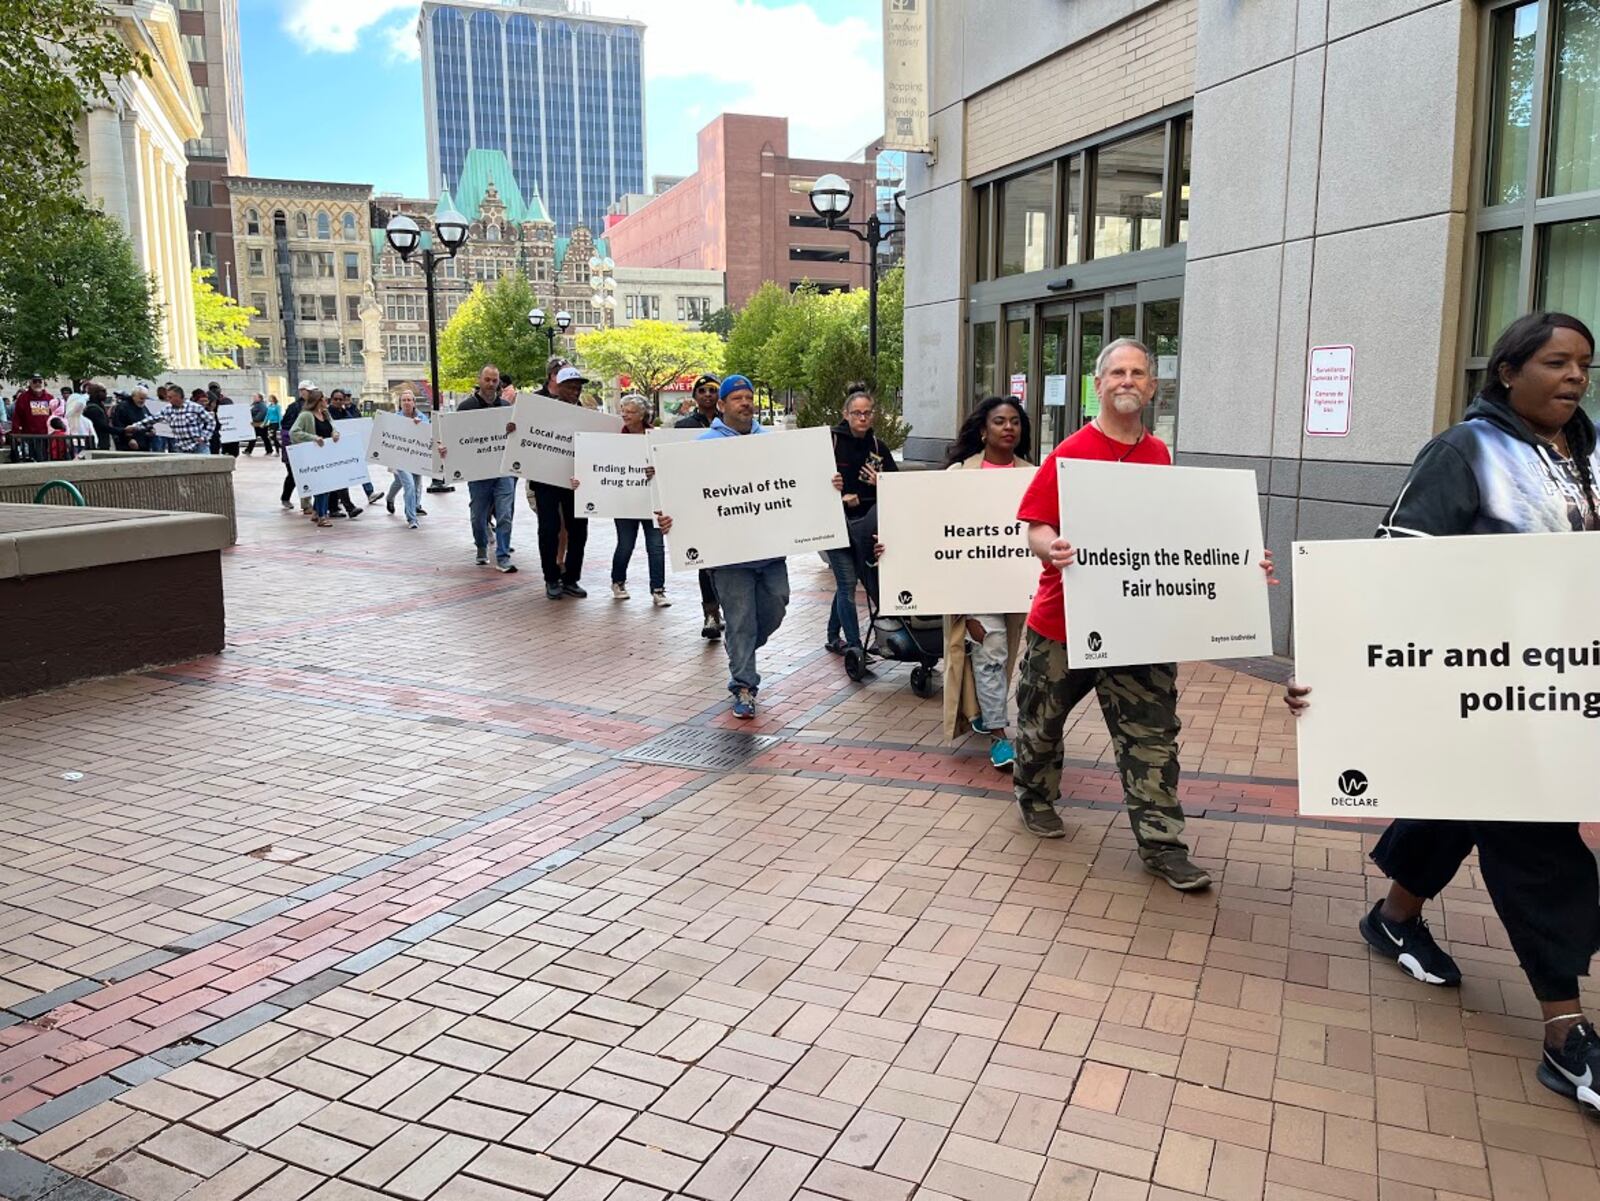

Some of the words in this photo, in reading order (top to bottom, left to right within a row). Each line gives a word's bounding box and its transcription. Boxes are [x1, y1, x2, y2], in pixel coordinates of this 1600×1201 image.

[459, 436, 489, 445] College
[530, 426, 554, 438] Local
[555, 434, 573, 443] and
[396, 445, 410, 453] and
[299, 465, 325, 474] Refugee
[325, 457, 359, 469] community
[593, 465, 626, 475] Ending
[601, 477, 624, 488] drug
[703, 483, 753, 499] Revival
[757, 480, 771, 492] of
[773, 478, 796, 489] the
[718, 501, 761, 517] family
[765, 497, 793, 511] unit
[944, 524, 1000, 538] Hearts
[1004, 521, 1022, 536] of
[935, 549, 962, 561] our
[1299, 546, 1309, 555] 5.
[1076, 548, 1150, 571] Undesign
[1154, 548, 1180, 566] the
[1184, 548, 1240, 566] Redline
[1244, 549, 1250, 566] /
[1122, 579, 1152, 597] Fair
[1156, 578, 1217, 600] housing
[1368, 642, 1433, 668] Fair
[1443, 641, 1510, 667] and
[1522, 640, 1600, 674] equi
[1460, 685, 1600, 719] policing
[1331, 797, 1379, 807] DECLARE
